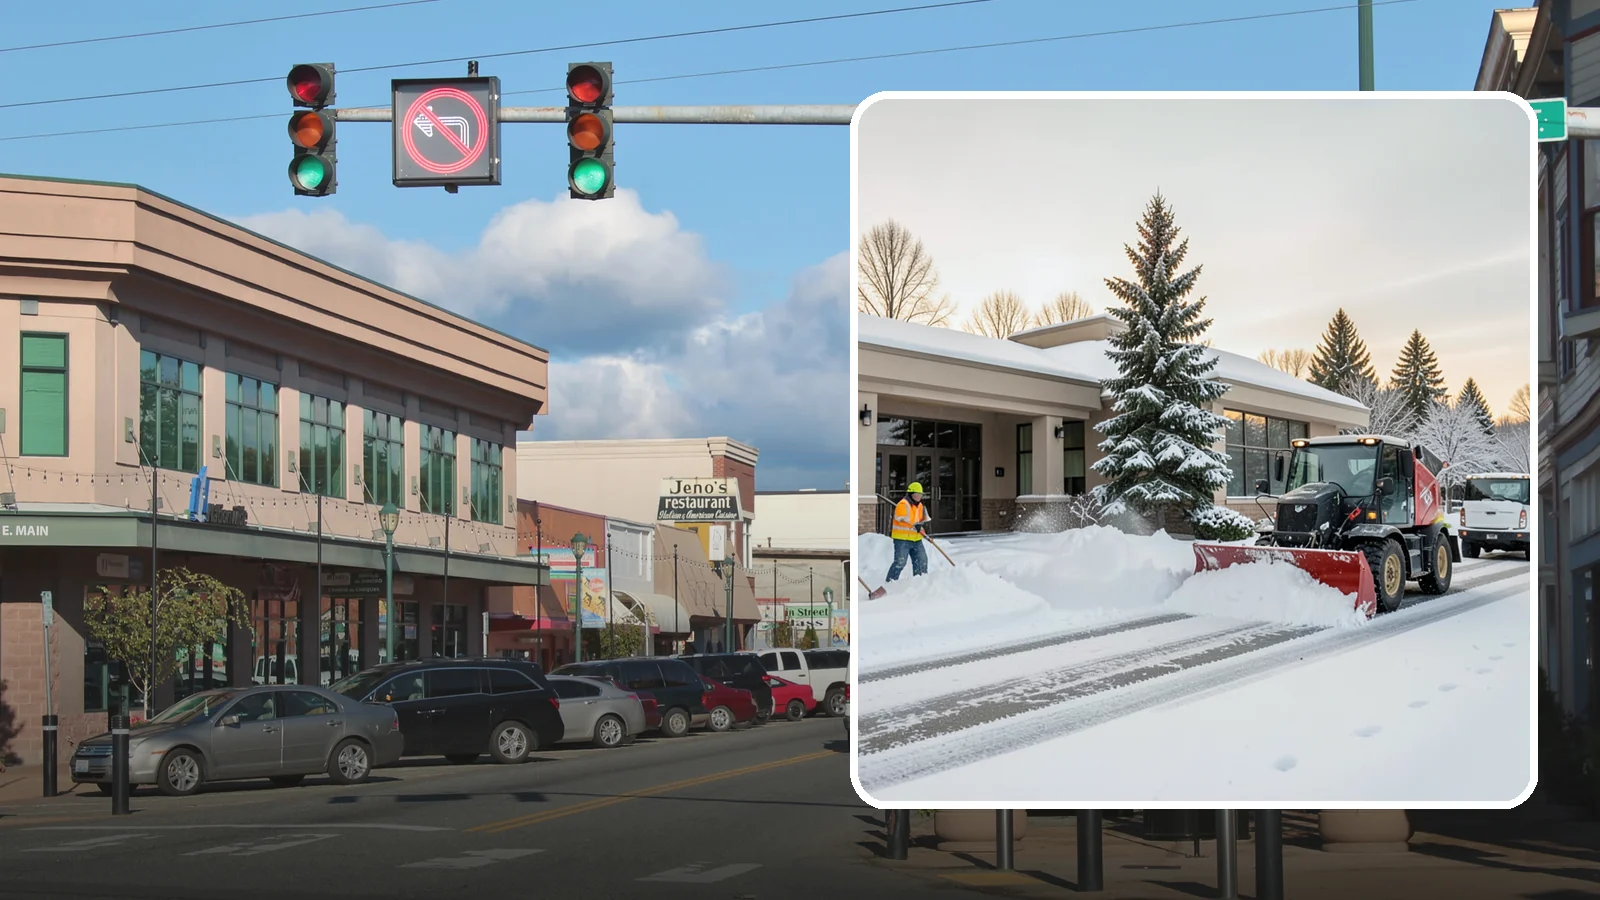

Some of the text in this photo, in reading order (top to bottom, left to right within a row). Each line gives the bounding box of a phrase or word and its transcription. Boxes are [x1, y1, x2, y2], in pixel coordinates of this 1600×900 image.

[669, 480, 728, 495] Jeno's
[665, 496, 731, 509] restaurant
[658, 509, 681, 520] Italian
[685, 509, 714, 520] American
[715, 509, 738, 519] Cuisine
[2, 525, 49, 536] E. MAIN
[797, 607, 829, 617] Street
[791, 619, 824, 627] lass
